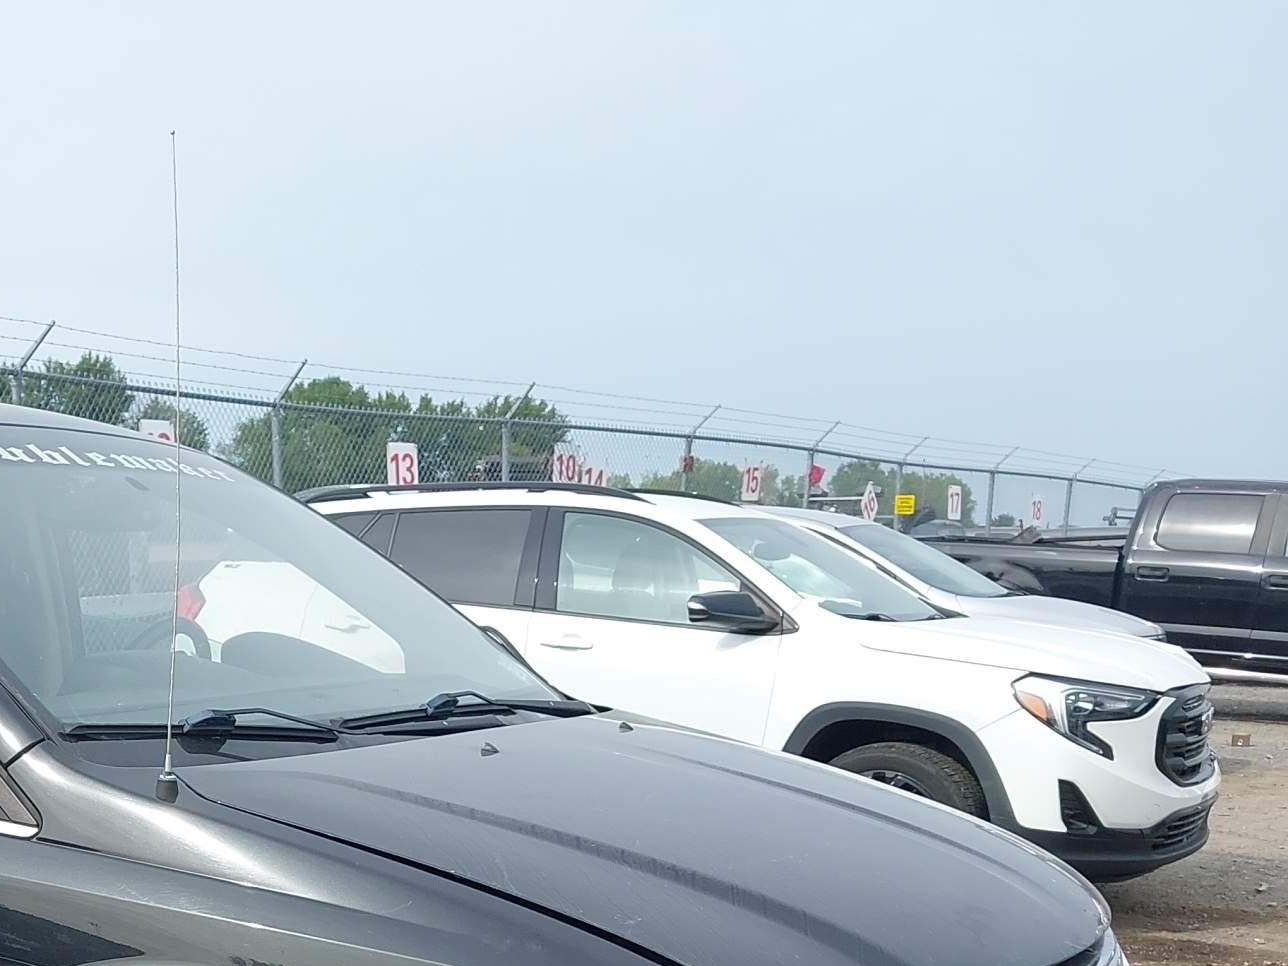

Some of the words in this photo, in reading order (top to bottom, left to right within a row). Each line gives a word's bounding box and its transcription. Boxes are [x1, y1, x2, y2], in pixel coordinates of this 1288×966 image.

[391, 453, 415, 485] 13
[557, 454, 576, 481] 10
[746, 467, 759, 494] 15
[950, 491, 960, 513] 17
[1032, 500, 1042, 521] 18
